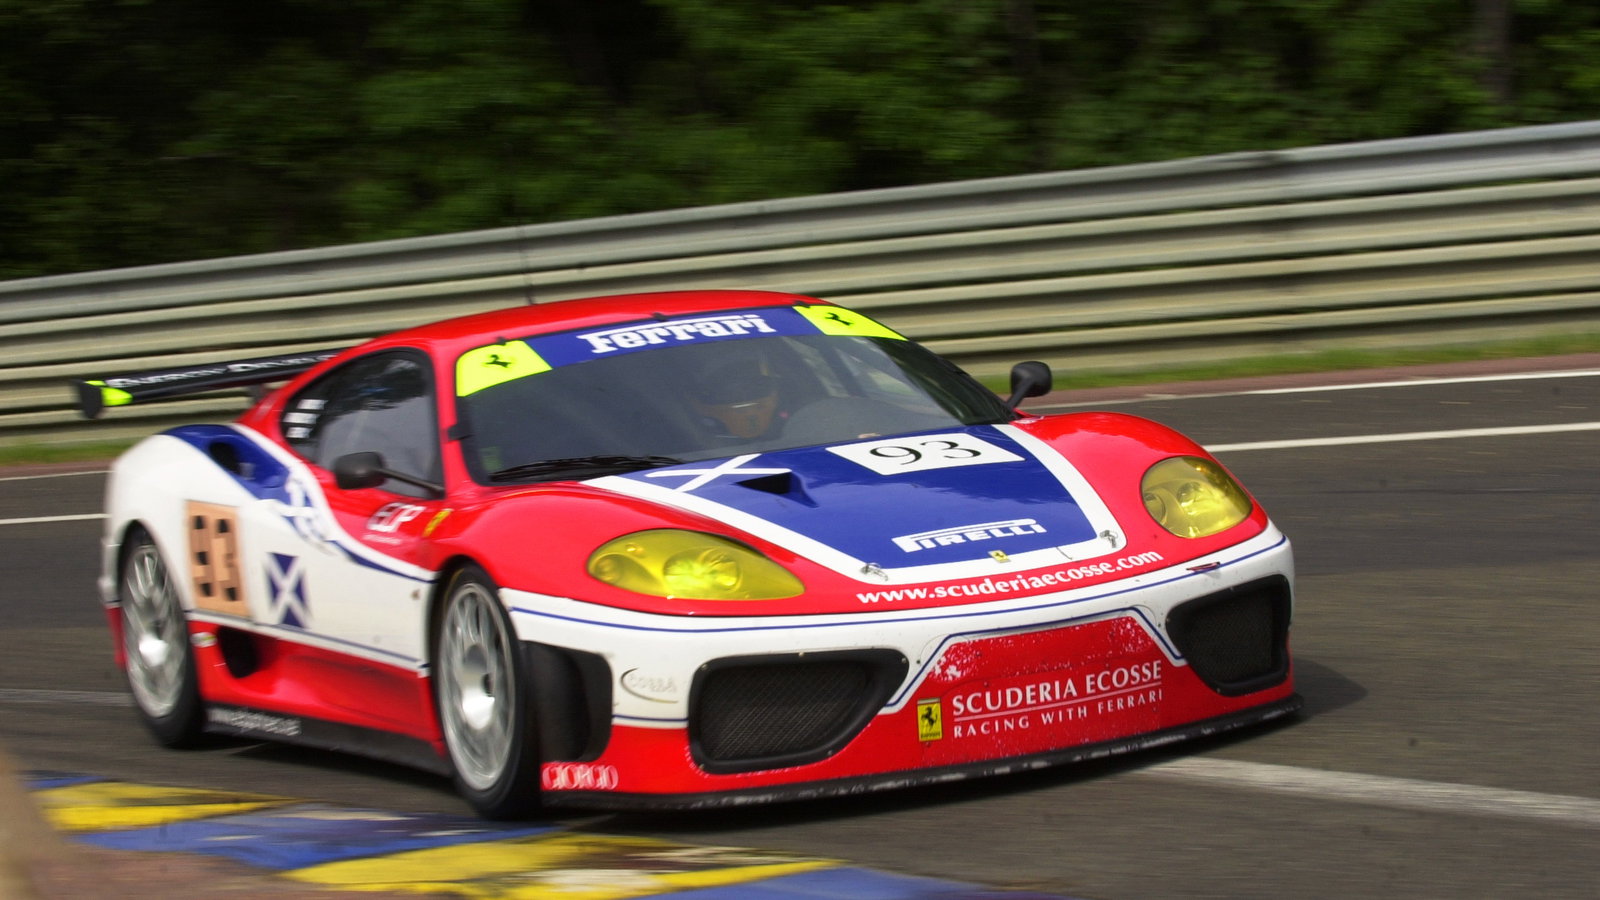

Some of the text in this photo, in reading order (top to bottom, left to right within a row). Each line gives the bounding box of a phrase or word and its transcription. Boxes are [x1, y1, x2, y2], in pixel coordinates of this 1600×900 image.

[576, 314, 777, 354] Ferrari
[869, 440, 982, 466] 93
[191, 514, 242, 603] 93
[891, 518, 1048, 553] PIRELLI
[856, 550, 1164, 604] www.scuderiaecosse.com
[952, 659, 1162, 717] SCUDERIA ECOSSE
[953, 687, 1163, 739] RACING WITH FERRARI
